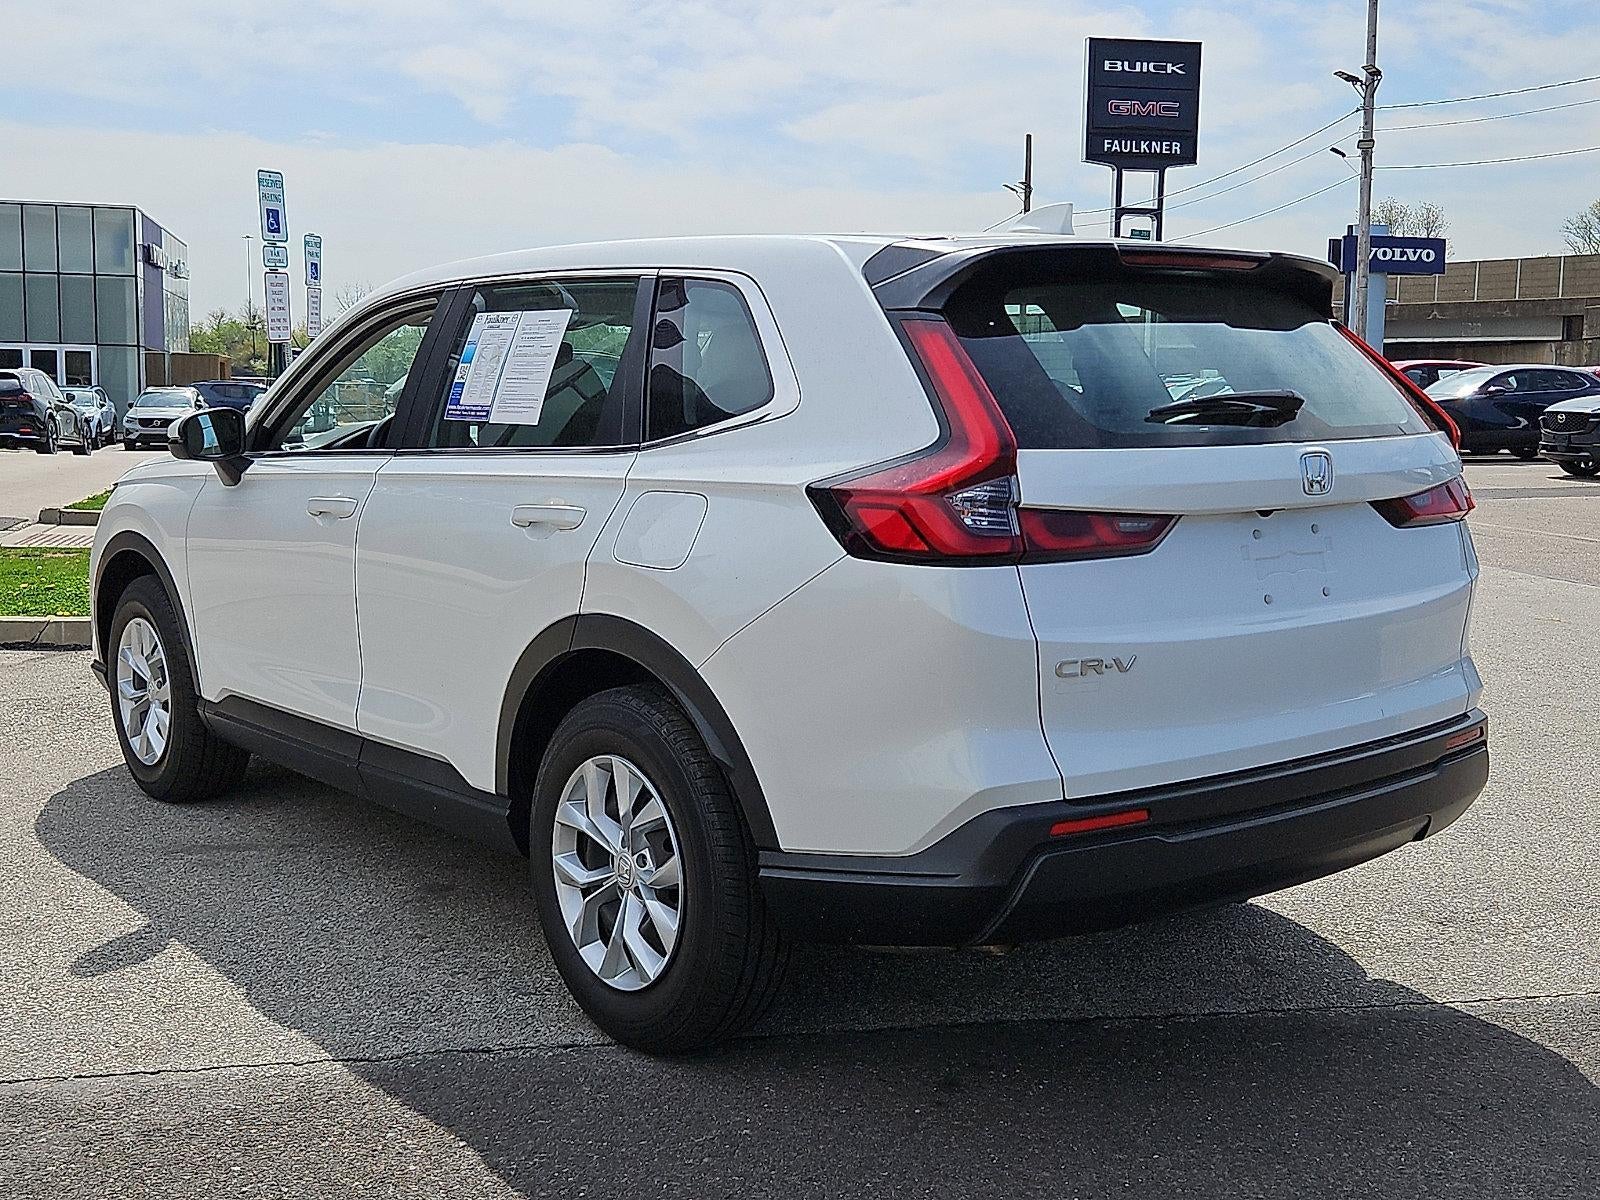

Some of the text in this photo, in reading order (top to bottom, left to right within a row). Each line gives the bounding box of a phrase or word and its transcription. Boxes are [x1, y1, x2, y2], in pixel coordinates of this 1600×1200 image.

[1104, 59, 1186, 75] BUICK
[1108, 99, 1180, 117] GMC
[1103, 139, 1181, 155] FAULKNER
[261, 191, 282, 203] PARKING
[1055, 654, 1138, 678] CR-V
